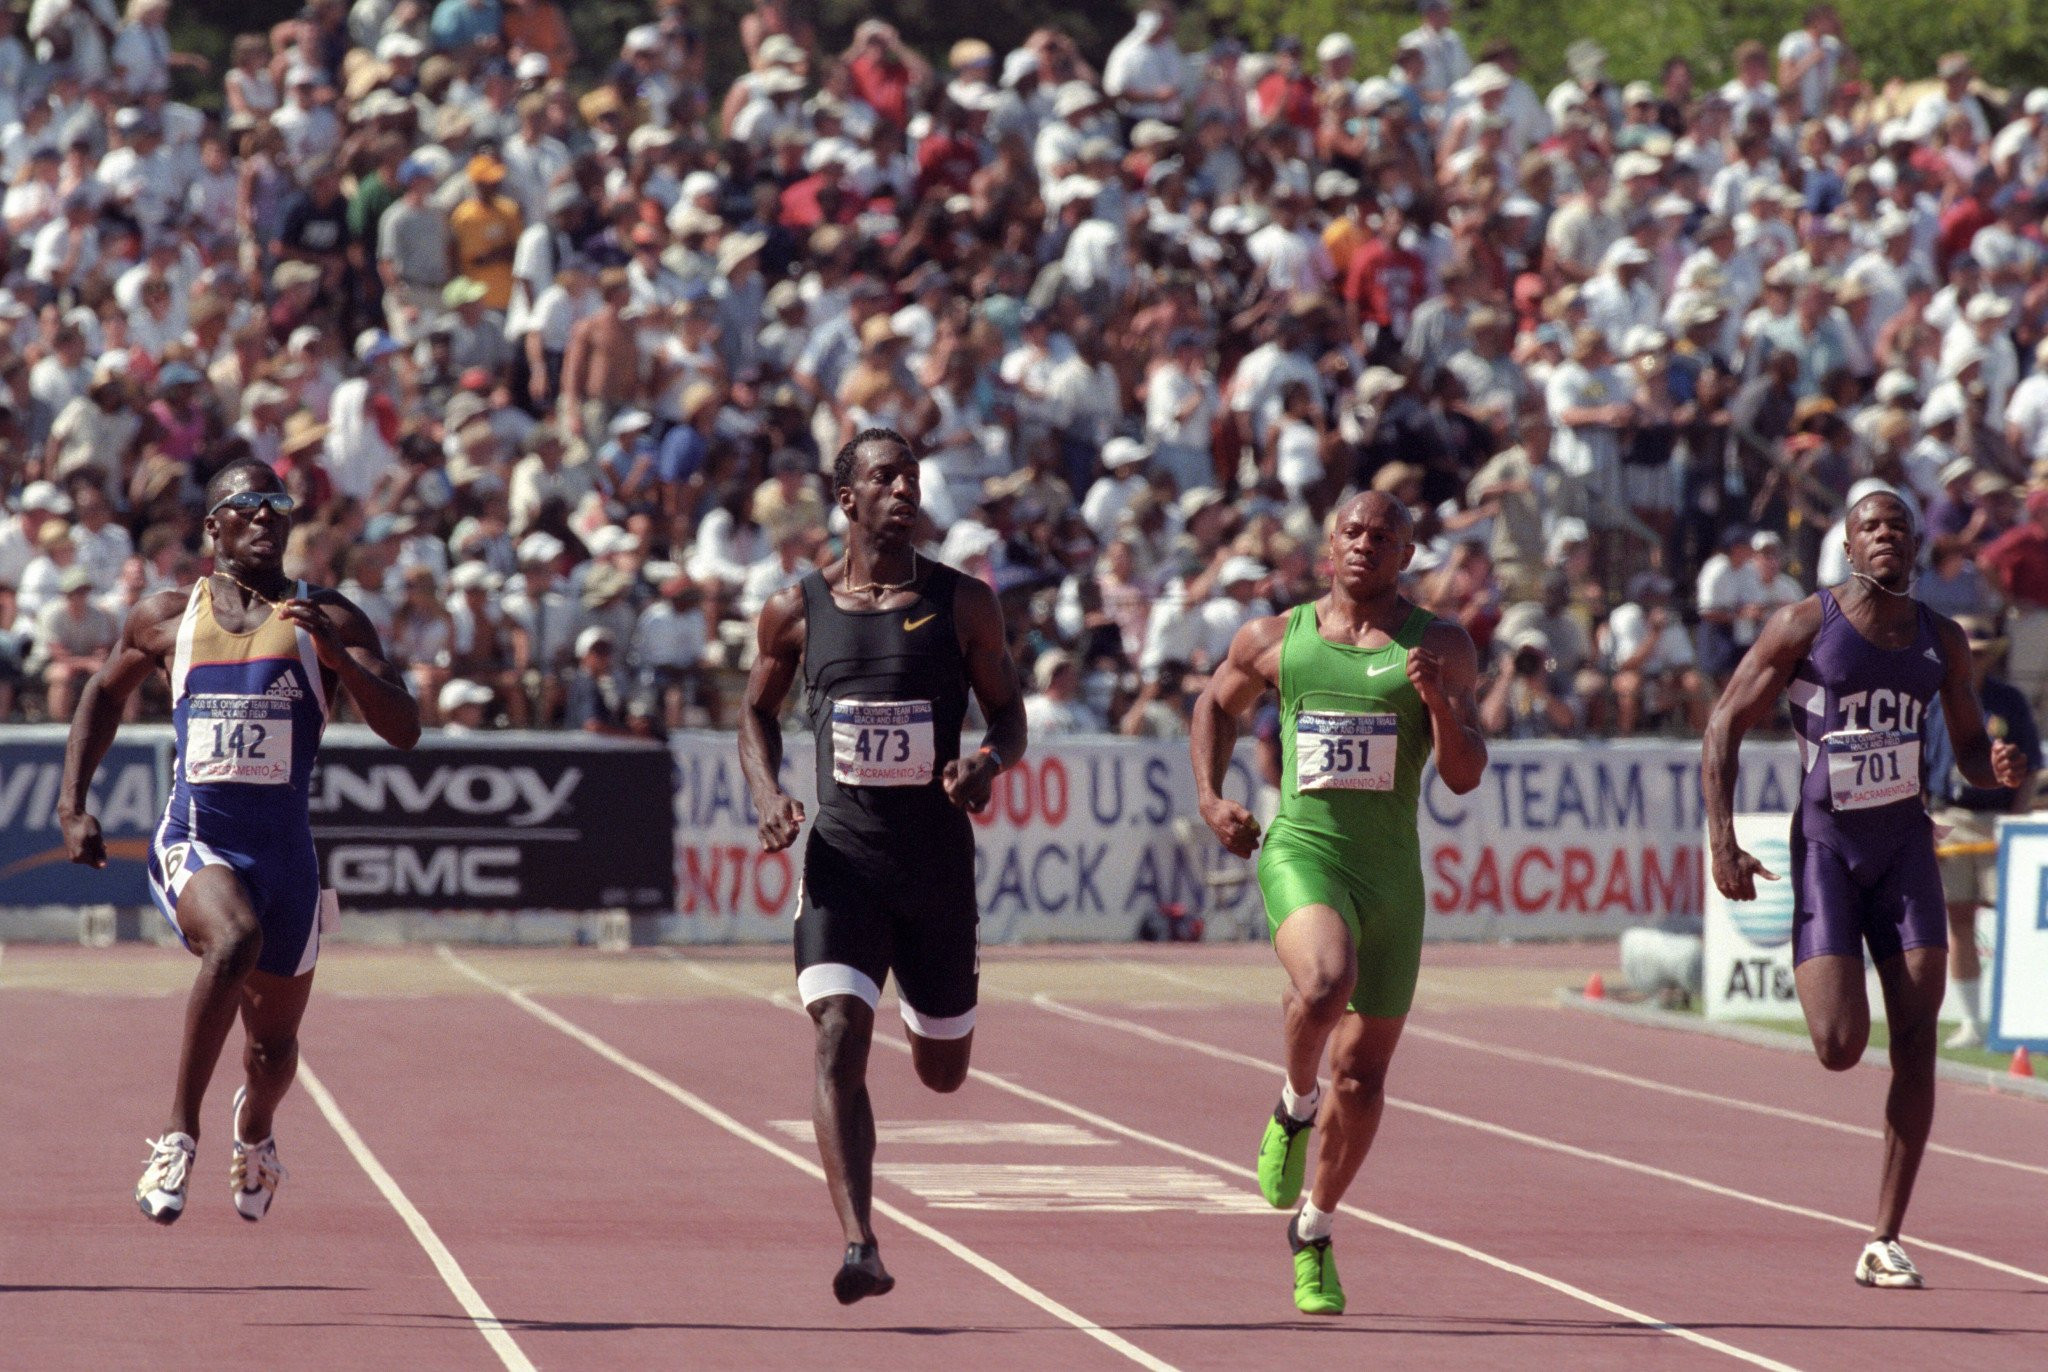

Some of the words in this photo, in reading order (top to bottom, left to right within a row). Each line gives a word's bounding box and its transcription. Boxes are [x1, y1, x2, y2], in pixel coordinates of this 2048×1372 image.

[251, 700, 269, 710] TEAM
[271, 701, 291, 710] TRIALS
[266, 687, 303, 698] adidas
[211, 709, 231, 718] TRACK
[232, 709, 247, 718] AND
[249, 709, 268, 718] FIELD
[854, 715, 875, 724] TRACK
[877, 715, 891, 724] AND
[892, 715, 910, 724] FIELD
[863, 707, 892, 716] OLYMPIC
[894, 706, 911, 715] TEAM
[912, 704, 932, 714] TRIALS
[1839, 688, 1922, 733] TCU
[211, 722, 266, 759] 142
[1341, 725, 1356, 734] AND
[855, 729, 910, 762] 473
[1320, 738, 1371, 772] 351
[855, 768, 915, 778] SACRAMENTO
[1851, 750, 1901, 786] 701
[1491, 762, 1645, 830] TEAM
[1853, 784, 1905, 802] SACRAMENTO
[165, 845, 184, 882] 6
[328, 845, 522, 897] GMC
